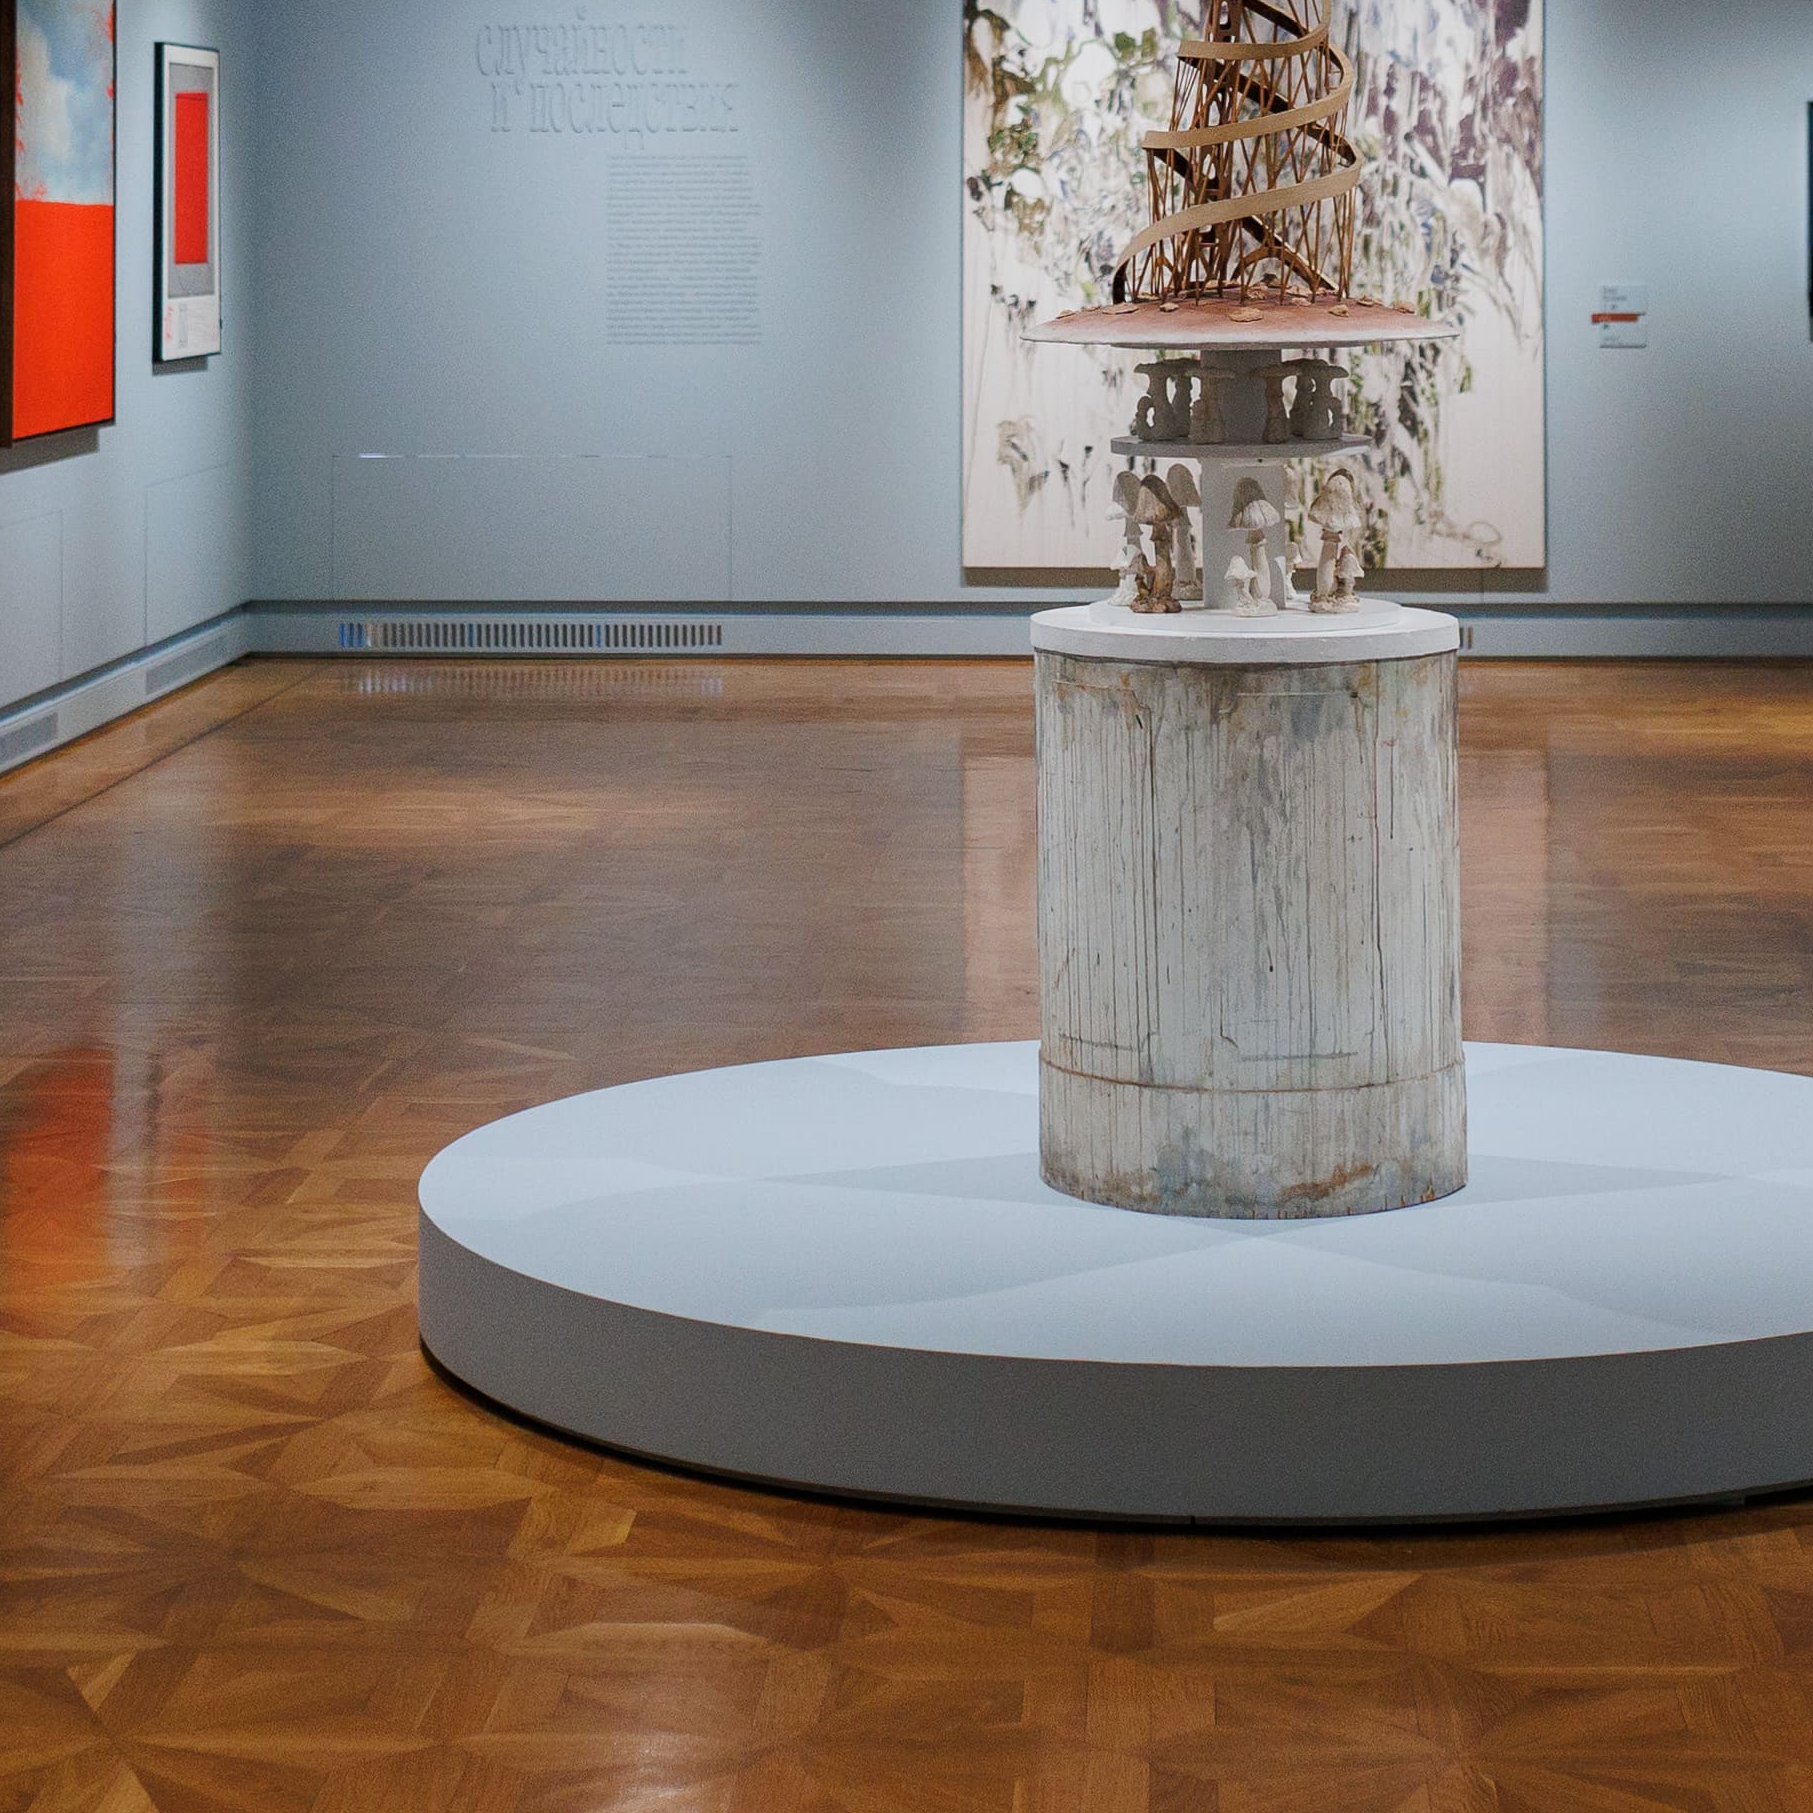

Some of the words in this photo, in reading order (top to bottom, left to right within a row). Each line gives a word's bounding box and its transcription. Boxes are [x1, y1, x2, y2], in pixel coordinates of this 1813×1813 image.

[475, 5, 690, 95] случайности
[490, 82, 512, 133] и
[529, 82, 740, 150] последствия
